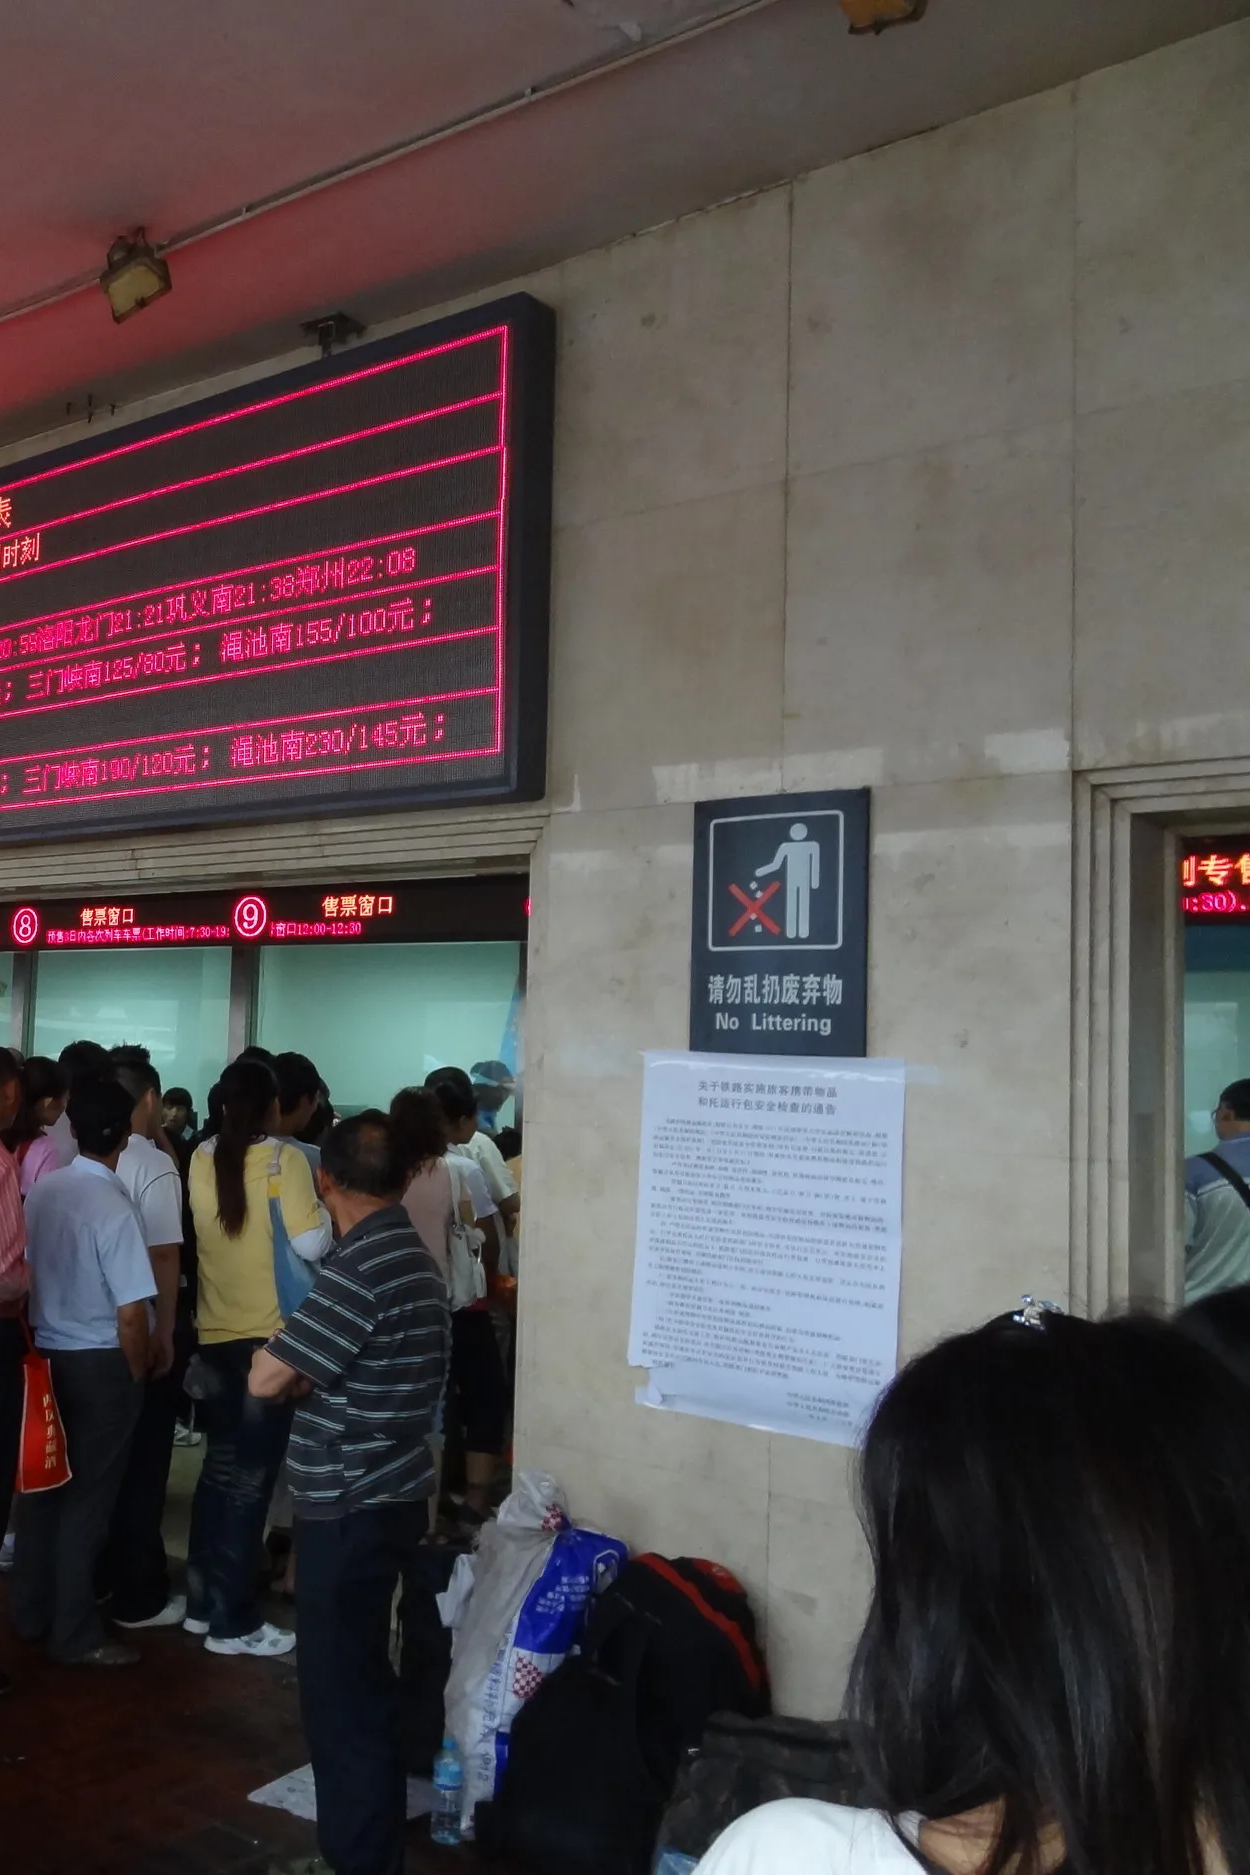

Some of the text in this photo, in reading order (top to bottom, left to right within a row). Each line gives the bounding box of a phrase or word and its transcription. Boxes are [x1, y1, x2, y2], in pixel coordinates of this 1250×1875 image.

[230, 711, 445, 768] 渑池南230/145元；
[80, 907, 135, 927] 售票窗口
[322, 894, 394, 918] 售票窗口
[270, 921, 362, 938] 窗口12:00-12:30
[708, 973, 843, 1006] 请勿乱扔废弃物
[715, 1012, 832, 1036] No Littering
[698, 1080, 838, 1099] 关于铁路实施旅客携带物品
[698, 1096, 837, 1116] 和托运行包安全检查的通告
